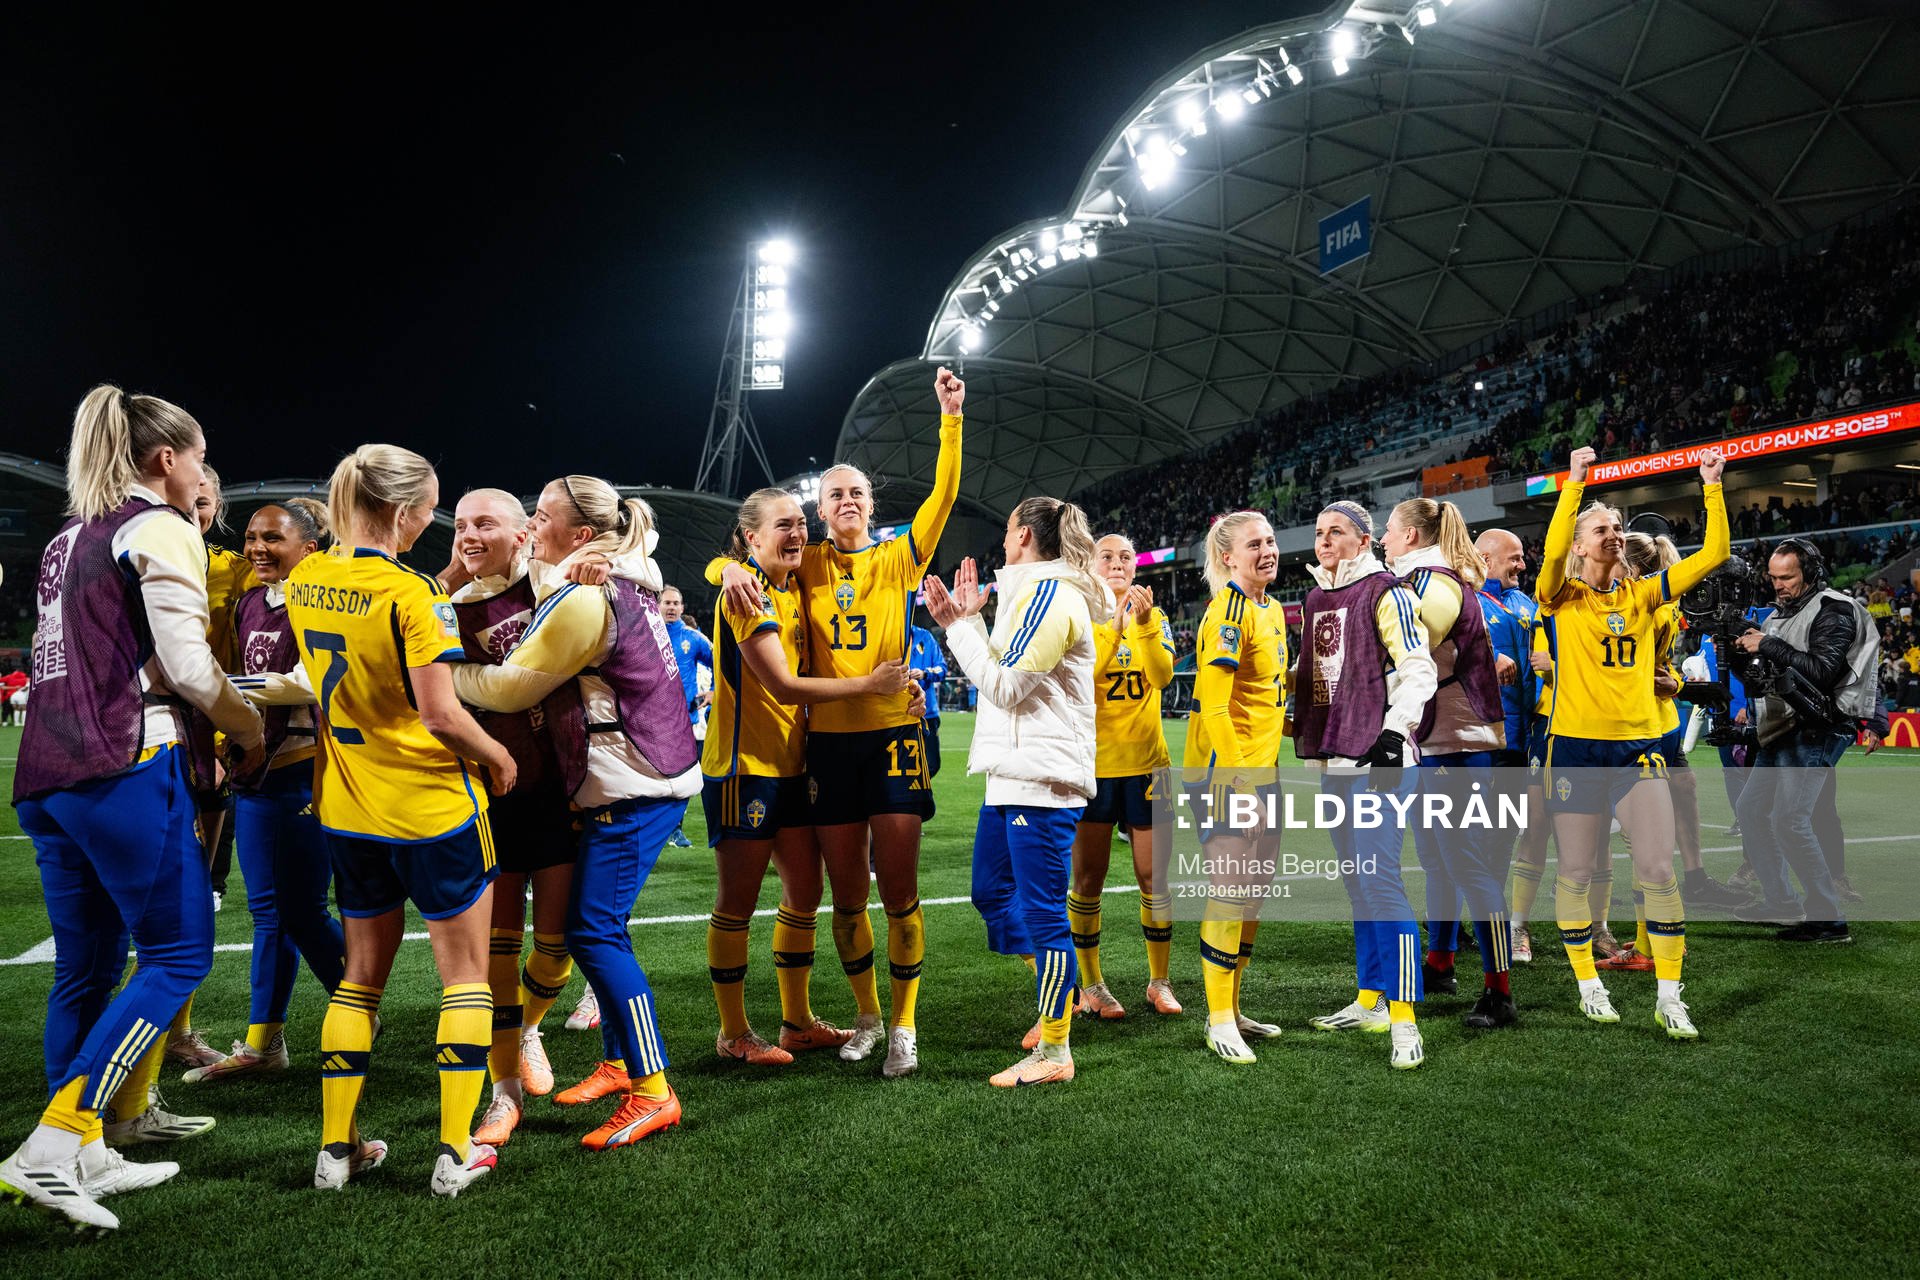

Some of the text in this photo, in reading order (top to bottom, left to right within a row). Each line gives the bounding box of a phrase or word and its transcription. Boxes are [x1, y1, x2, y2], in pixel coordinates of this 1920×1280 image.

[1326, 220, 1362, 255] FIFA
[1594, 466, 1621, 481] FIFA
[1621, 452, 1685, 476] WOMEN'S
[1741, 436, 1773, 454] CUP
[291, 582, 372, 616] ANDERSSON
[830, 614, 867, 650] 13
[1601, 636, 1637, 667] 10
[1105, 670, 1145, 701] 20
[1273, 673, 1286, 707] 1
[886, 739, 921, 776] 13
[1637, 752, 1671, 780] 10
